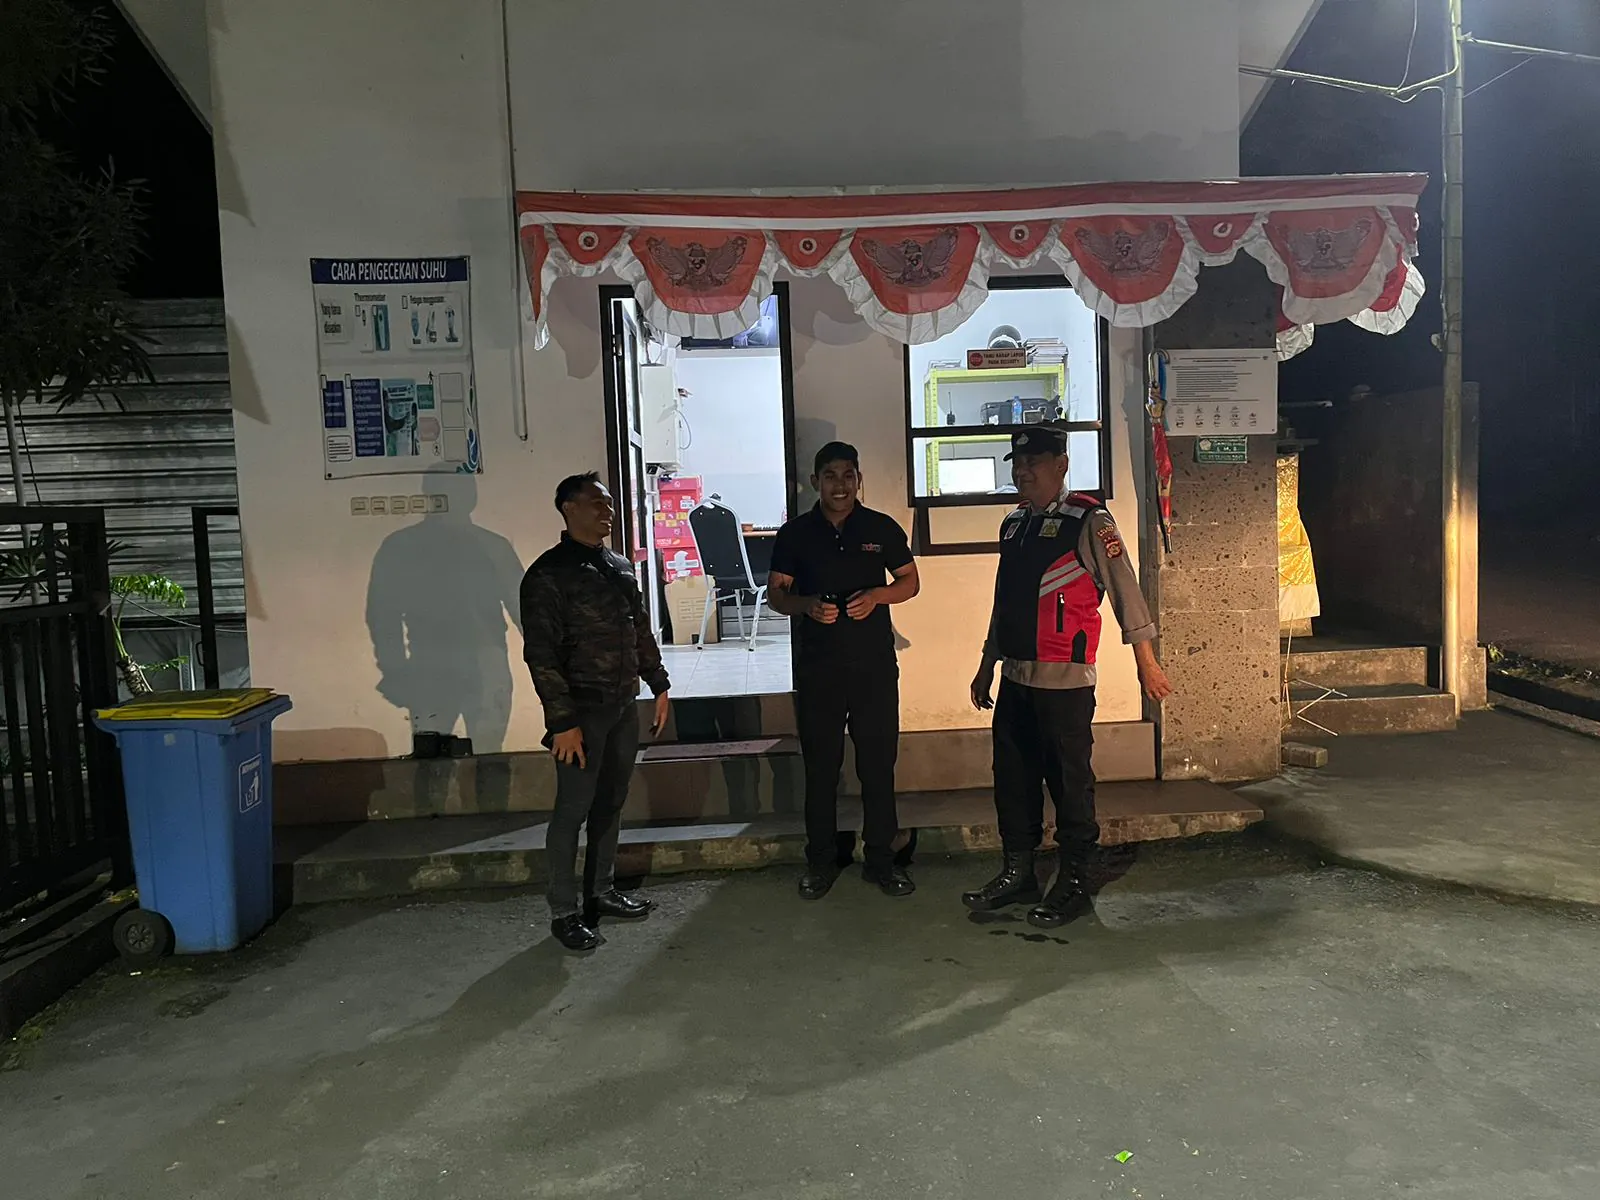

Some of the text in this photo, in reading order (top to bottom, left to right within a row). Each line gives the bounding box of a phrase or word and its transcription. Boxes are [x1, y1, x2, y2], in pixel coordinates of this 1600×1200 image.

[331, 260, 447, 281] CARA PENGECEKAN SUHU
